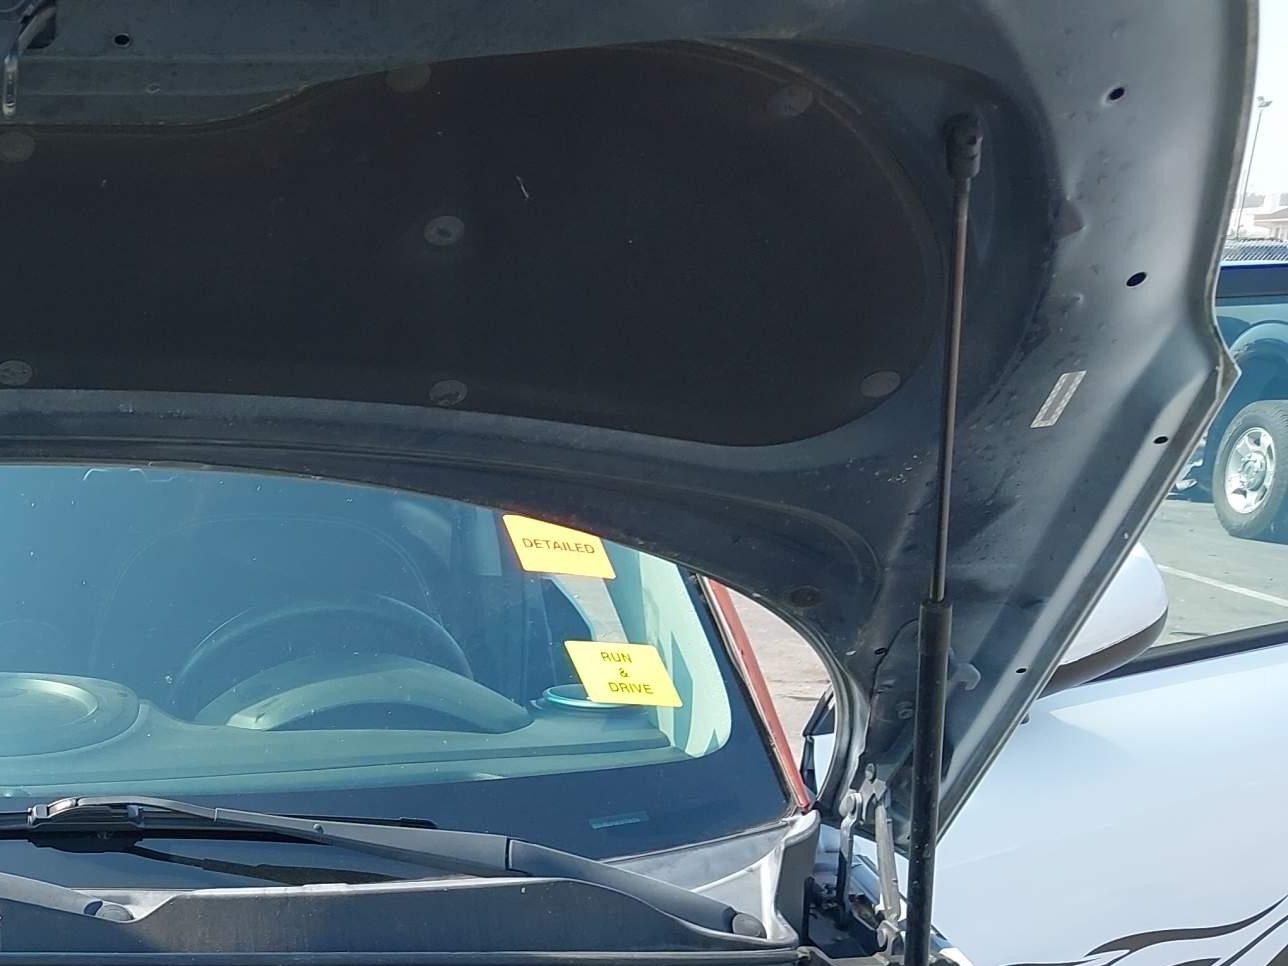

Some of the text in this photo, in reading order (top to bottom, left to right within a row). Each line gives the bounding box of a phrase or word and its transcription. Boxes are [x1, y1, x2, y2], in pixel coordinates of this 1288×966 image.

[522, 537, 595, 554] DETAILED
[600, 651, 633, 664] RUN
[619, 667, 629, 678] &
[608, 682, 654, 694] DRIVE
